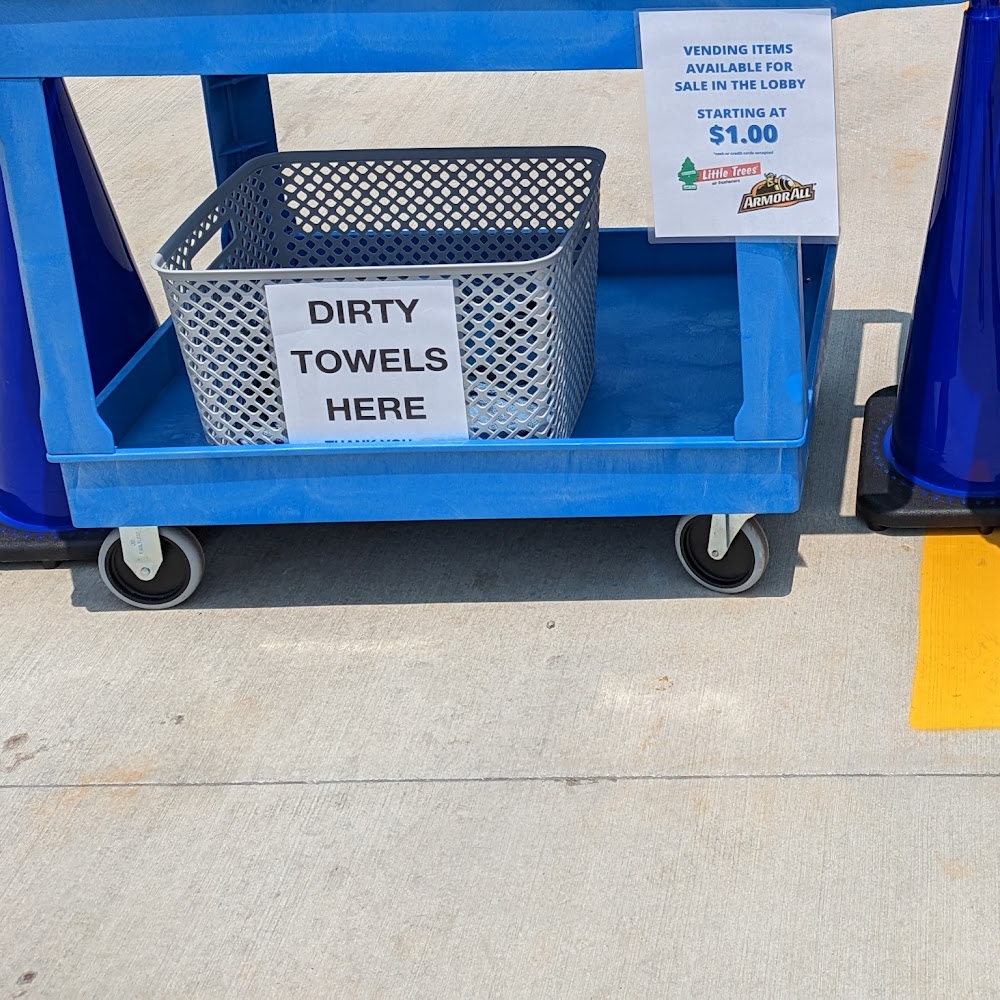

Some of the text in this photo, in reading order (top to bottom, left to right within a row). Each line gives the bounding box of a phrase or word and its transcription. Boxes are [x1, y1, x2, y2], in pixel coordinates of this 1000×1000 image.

[683, 44, 793, 56] VENDING ITEMS
[686, 61, 793, 74] AVAILABLE FOR
[674, 79, 806, 92] SALE IN THE LOBBY
[697, 107, 787, 119] STARTING AT
[709, 124, 778, 145] $1.00
[703, 167, 729, 180] Little
[731, 166, 757, 177] Trees
[308, 299, 419, 324] DIRTY
[290, 347, 448, 374] TOWELS
[326, 396, 427, 421] HERE
